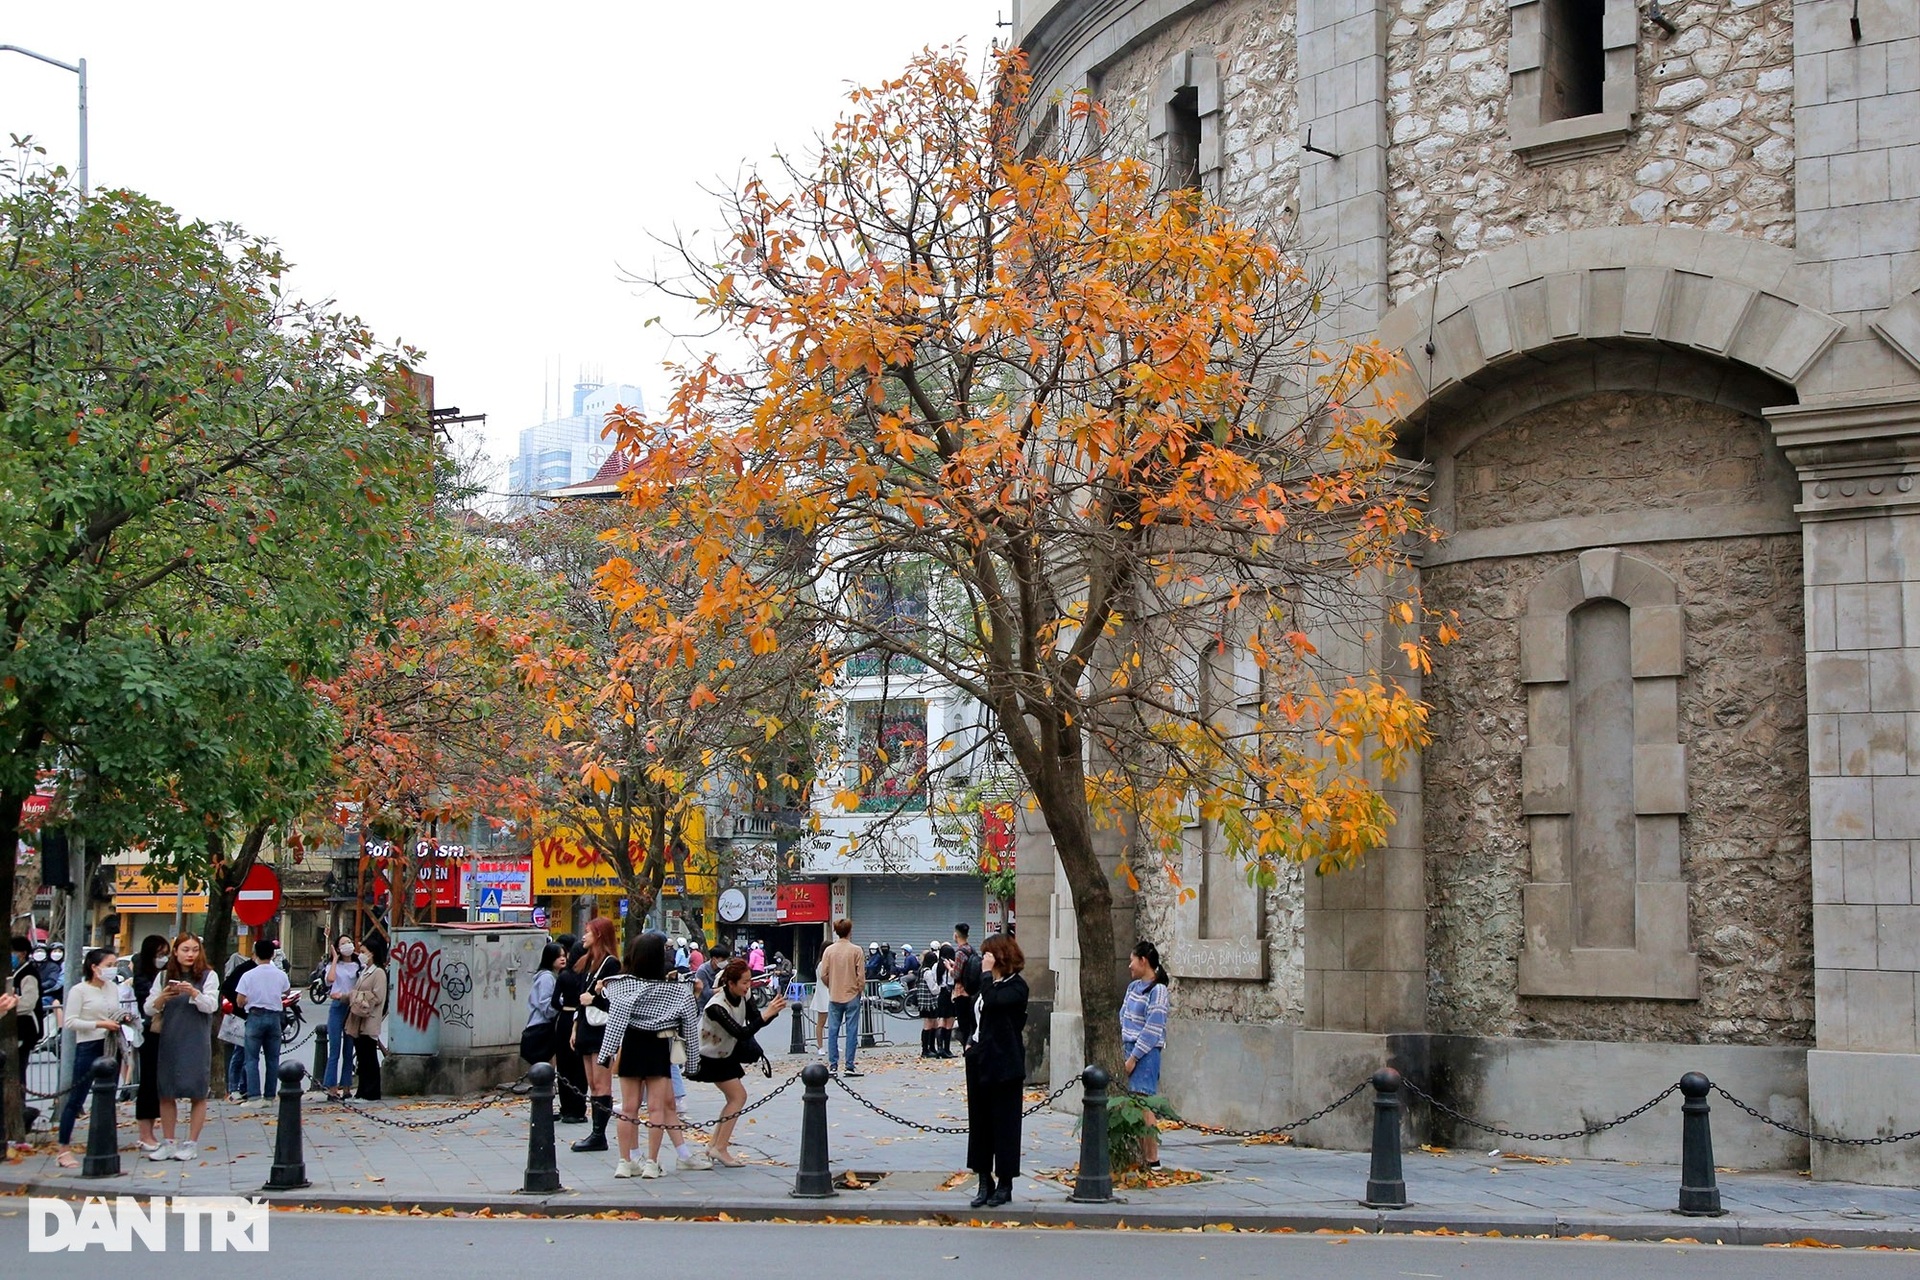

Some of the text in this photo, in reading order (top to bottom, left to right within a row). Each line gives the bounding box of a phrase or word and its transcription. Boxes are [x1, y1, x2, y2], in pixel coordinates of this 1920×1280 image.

[811, 839, 831, 852] Shop
[546, 874, 564, 887] NHÀ
[565, 876, 585, 887] KHAI
[585, 873, 607, 887] THÁC
